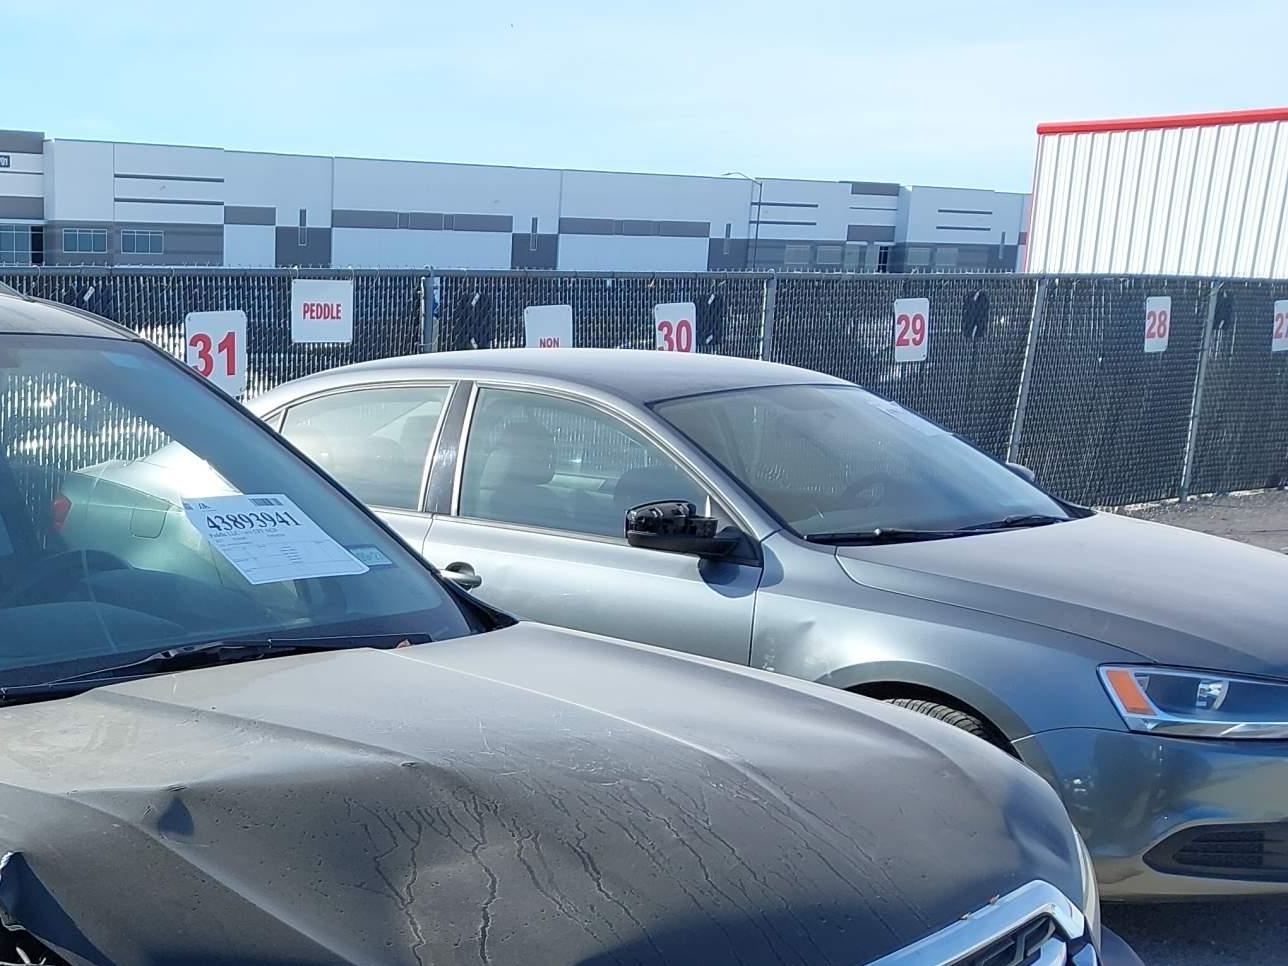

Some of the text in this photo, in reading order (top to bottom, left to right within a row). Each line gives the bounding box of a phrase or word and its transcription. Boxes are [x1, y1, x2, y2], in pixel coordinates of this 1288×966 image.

[302, 303, 342, 320] PEDDLE
[1146, 310, 1168, 339] 28
[657, 319, 692, 353] 30
[895, 313, 926, 347] 29
[1274, 313, 1288, 339] 2
[189, 331, 236, 377] 31
[539, 338, 560, 348] NON
[206, 511, 301, 532] 43893941
